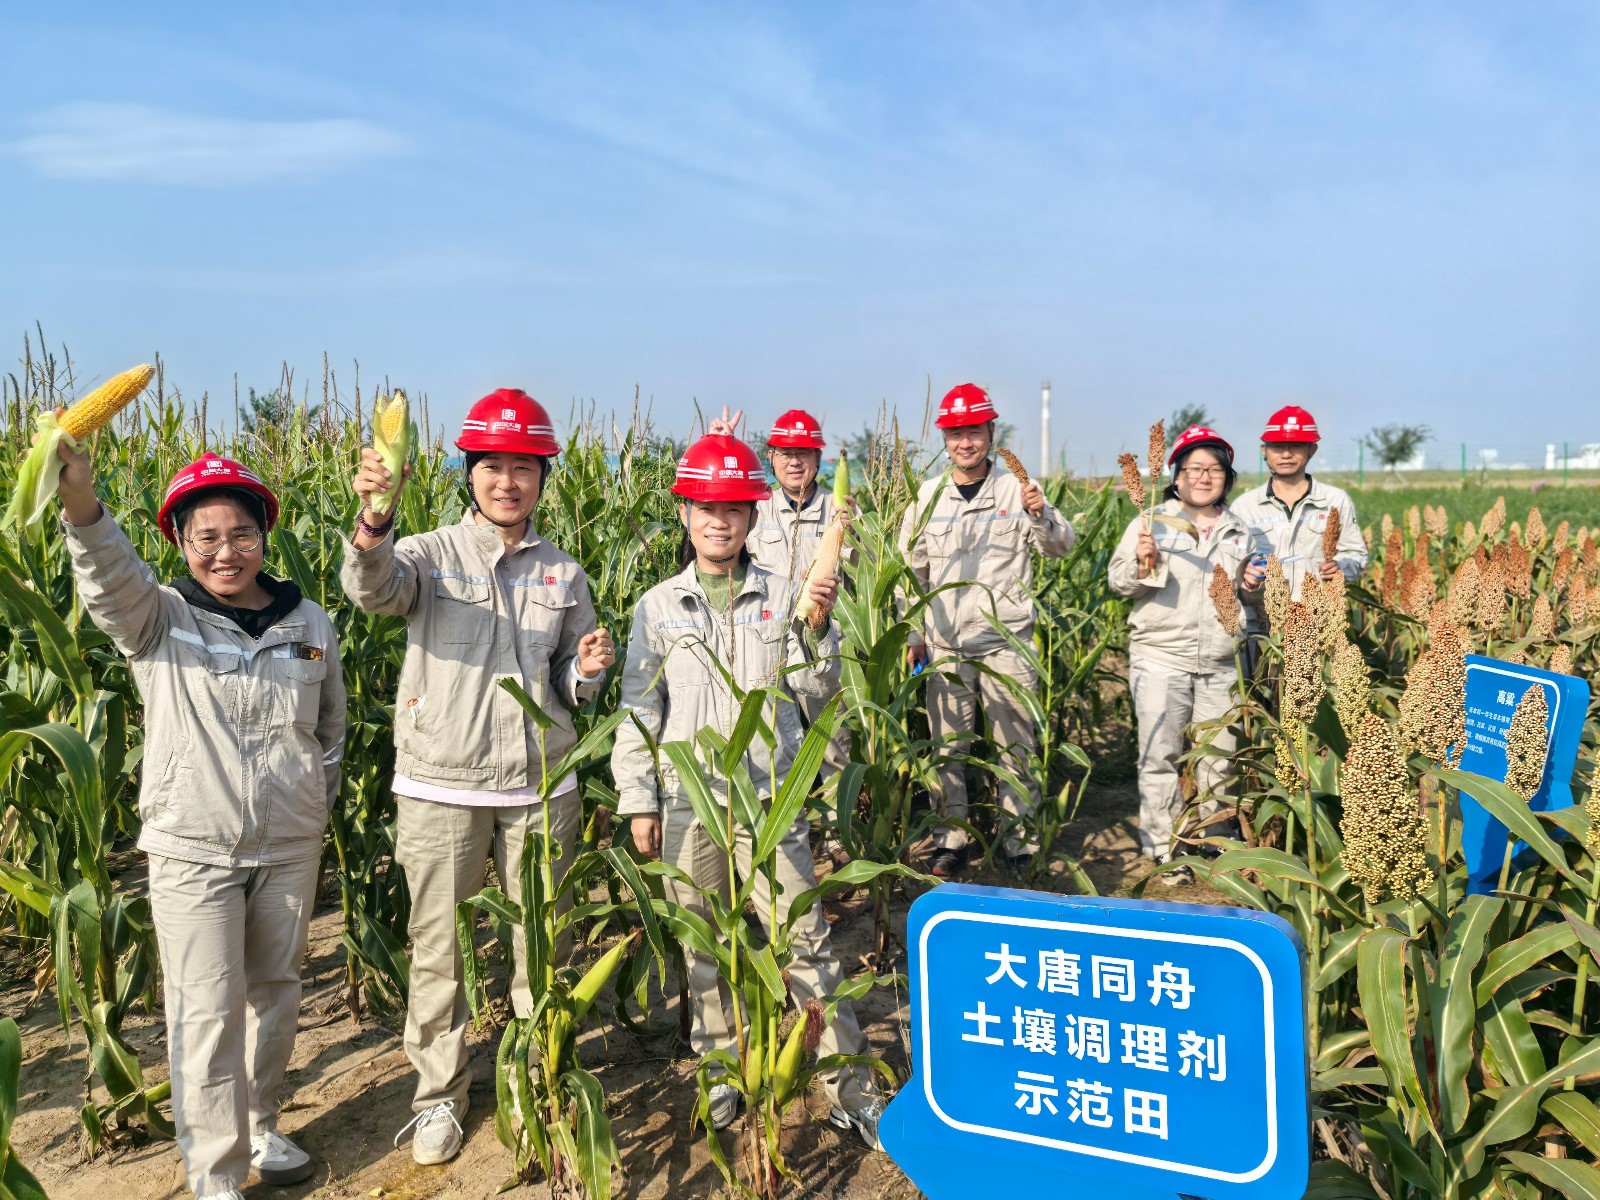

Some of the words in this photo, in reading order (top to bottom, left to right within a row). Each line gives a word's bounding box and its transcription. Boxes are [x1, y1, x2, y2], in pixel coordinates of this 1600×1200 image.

[985, 943, 1195, 1009] 大唐同舟
[961, 1001, 1228, 1082] 土壤调理剂
[1013, 1070, 1169, 1141] 示范田
